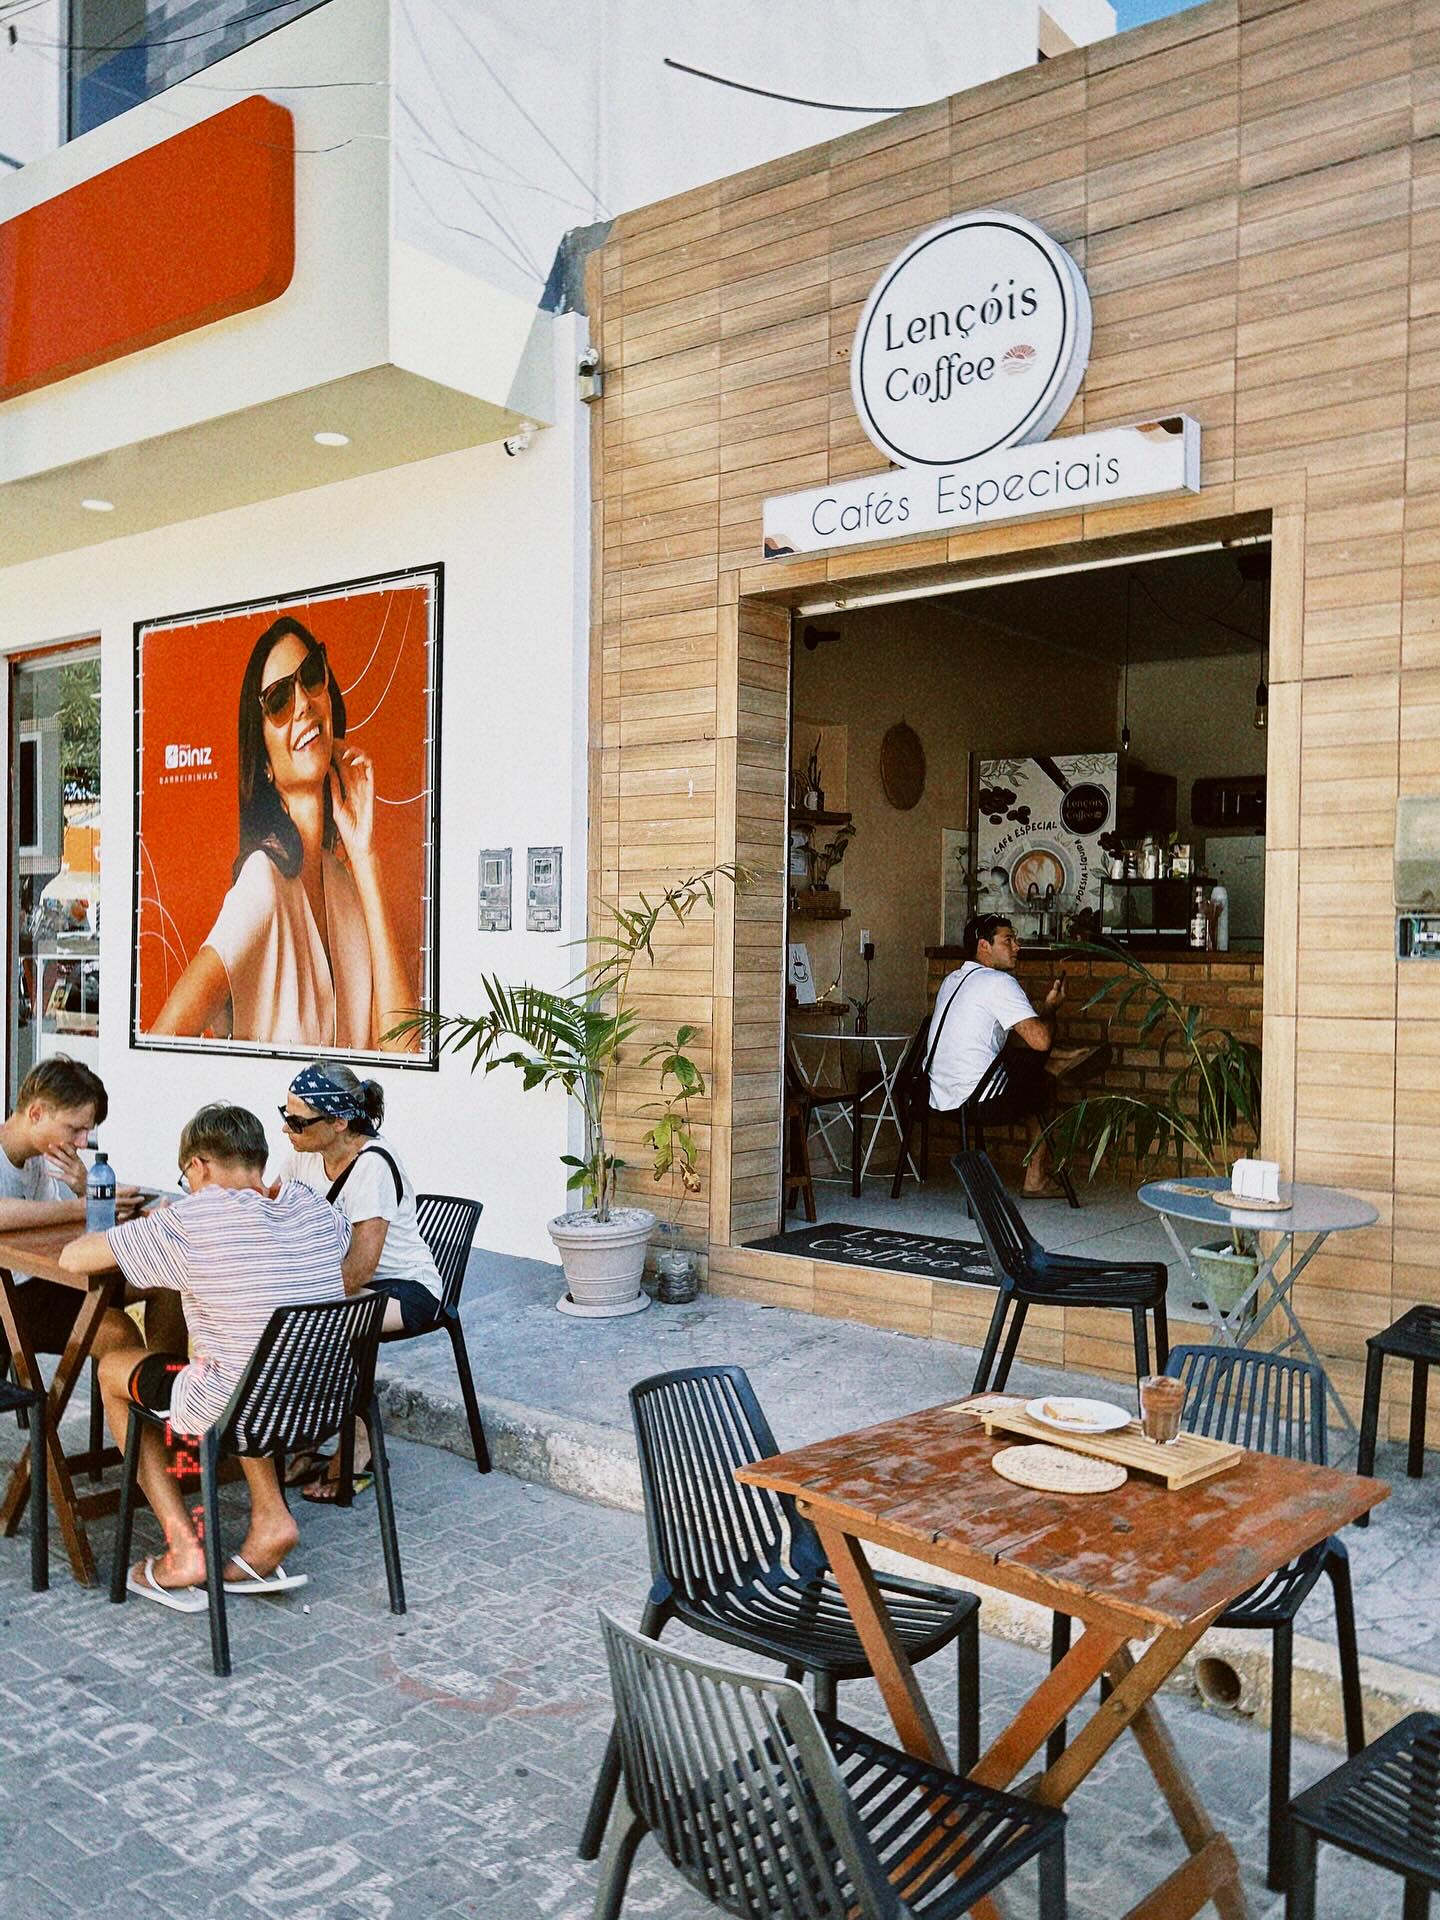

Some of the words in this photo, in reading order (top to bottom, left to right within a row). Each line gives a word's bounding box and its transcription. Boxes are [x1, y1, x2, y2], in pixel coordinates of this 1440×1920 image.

[885, 279, 1038, 352] Lençóis
[885, 353, 996, 403] Coffee
[811, 492, 911, 536] Cafés
[936, 453, 1121, 515] Especiais
[1014, 821, 1057, 838] ESPECIAL
[809, 1240, 960, 1268] Coffee
